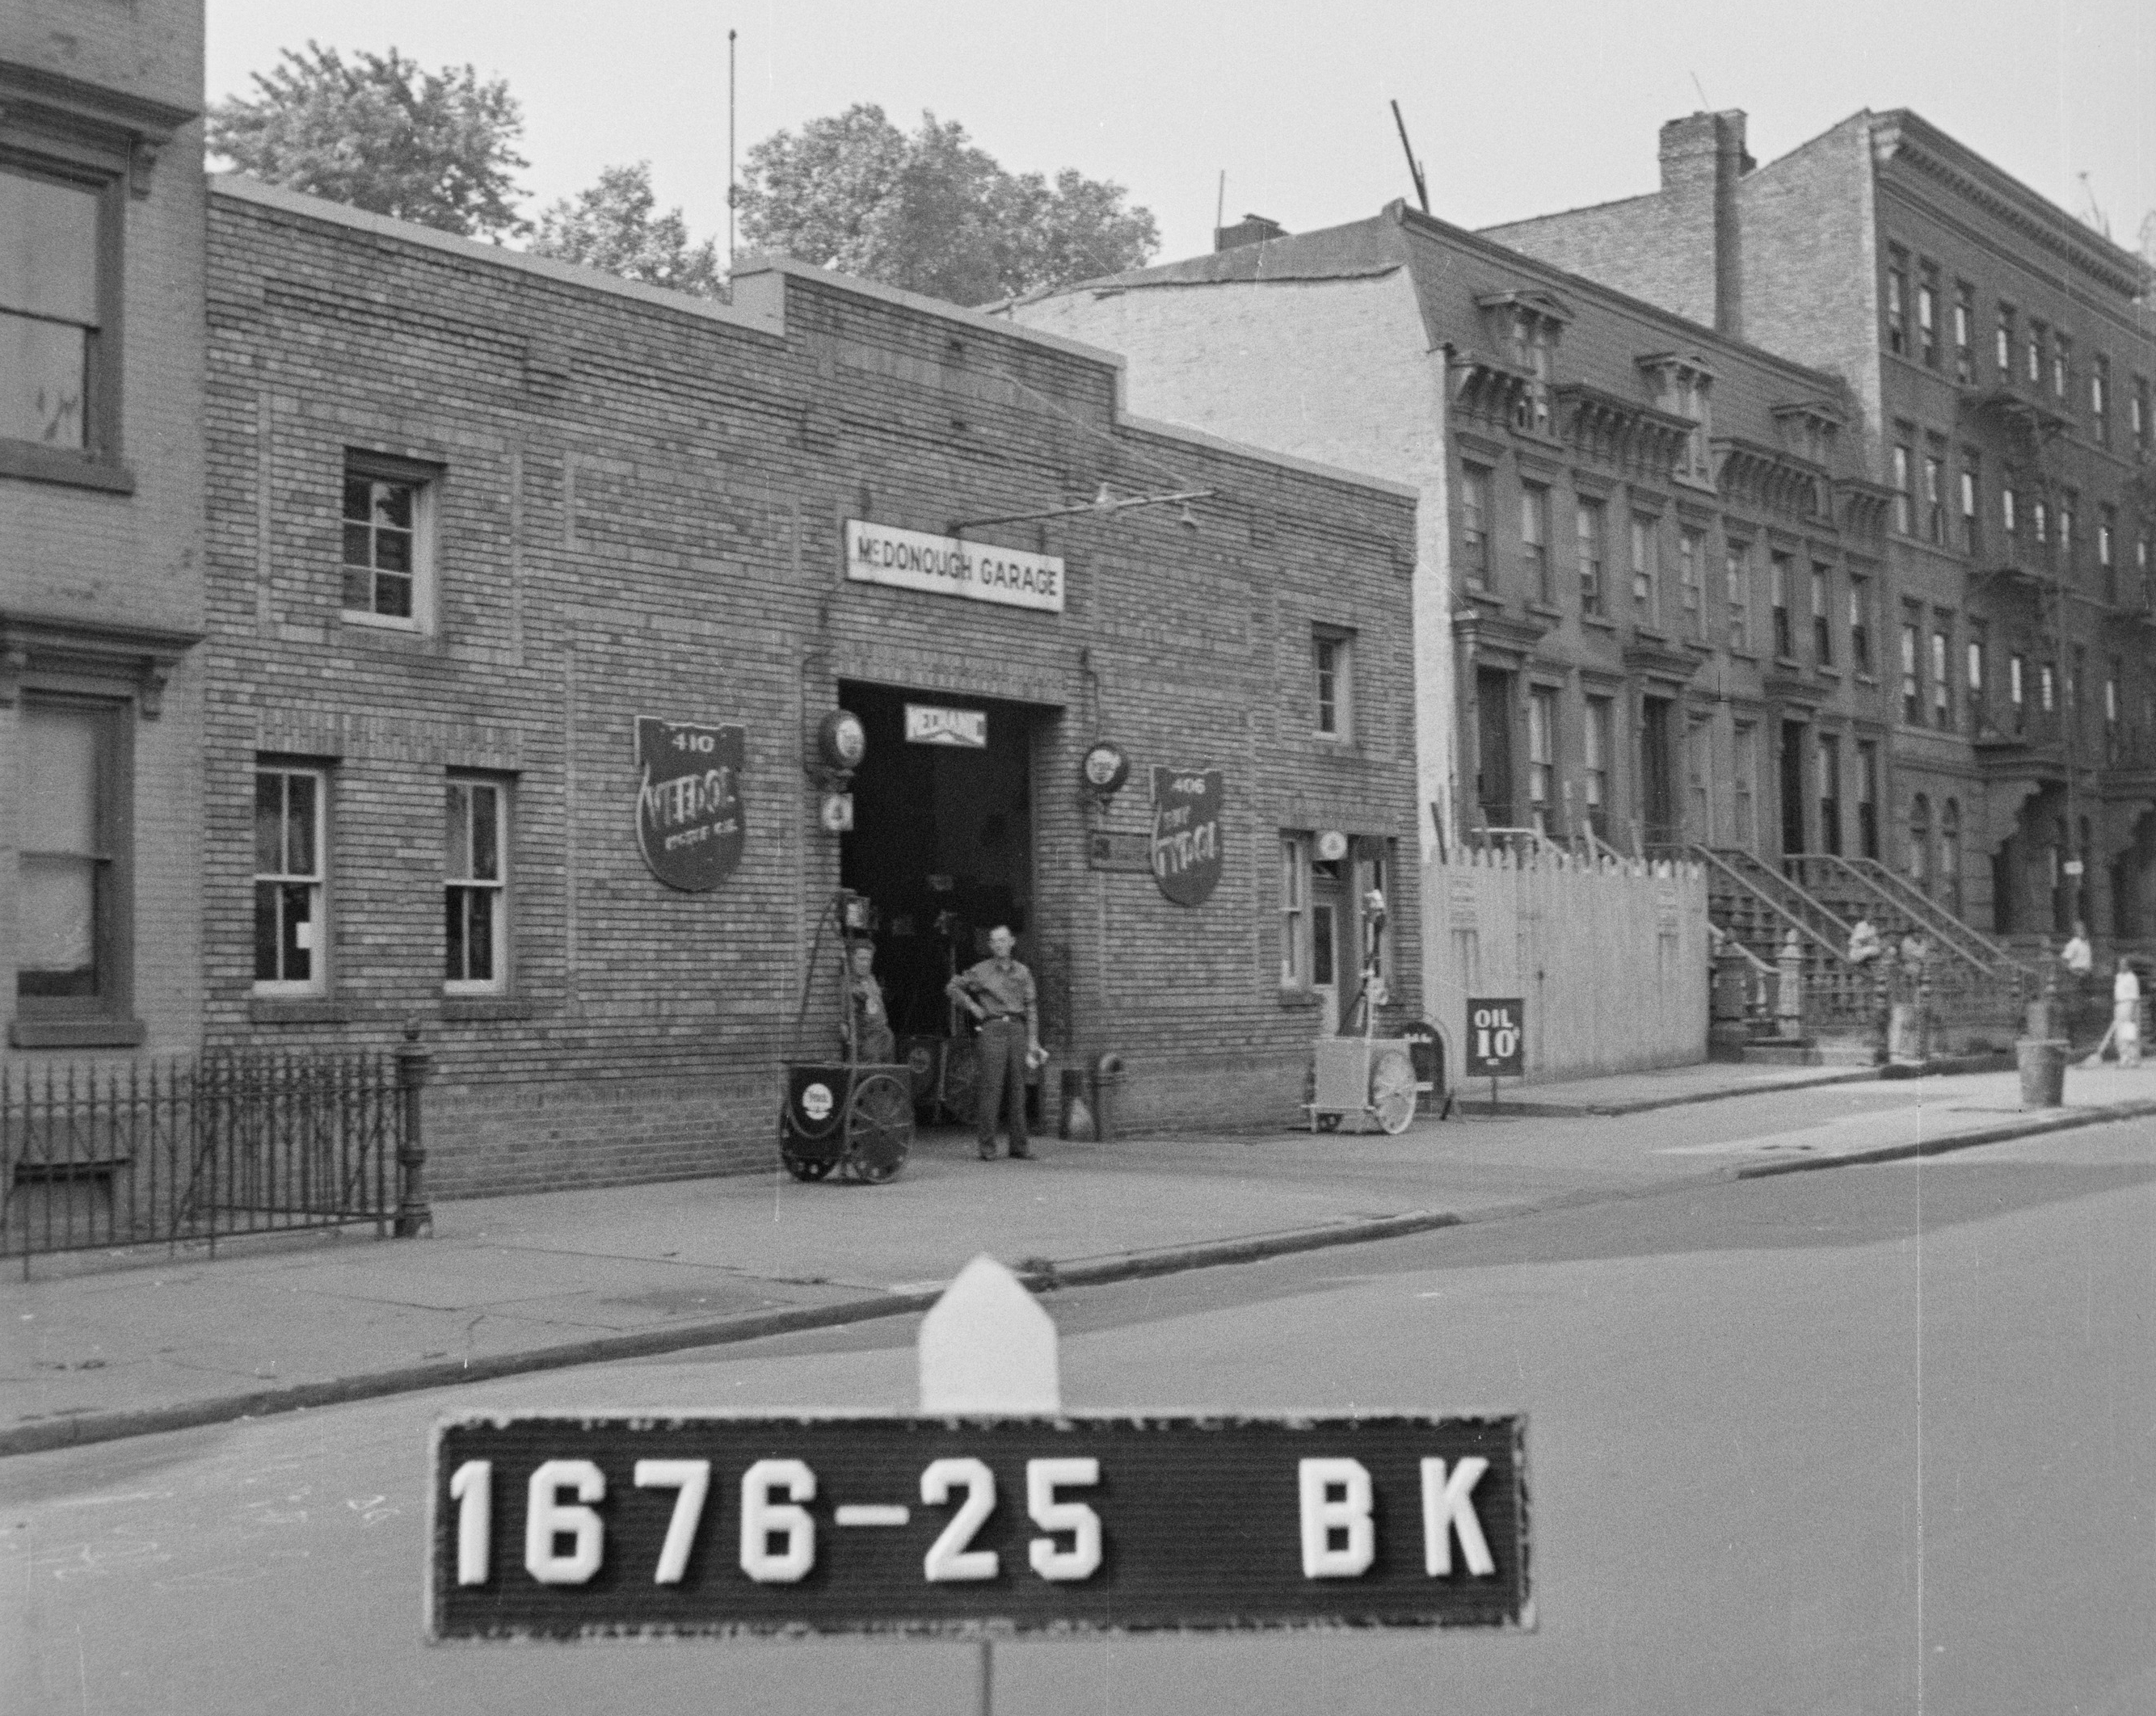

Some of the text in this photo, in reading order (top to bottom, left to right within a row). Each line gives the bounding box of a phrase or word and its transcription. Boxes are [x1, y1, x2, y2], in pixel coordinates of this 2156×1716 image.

[980, 557, 1057, 597] GARAGE
[672, 733, 715, 753] 410
[1173, 777, 1206, 795] 406
[1474, 1008, 1514, 1028] OIL
[449, 1457, 1103, 1586] 1676-25
